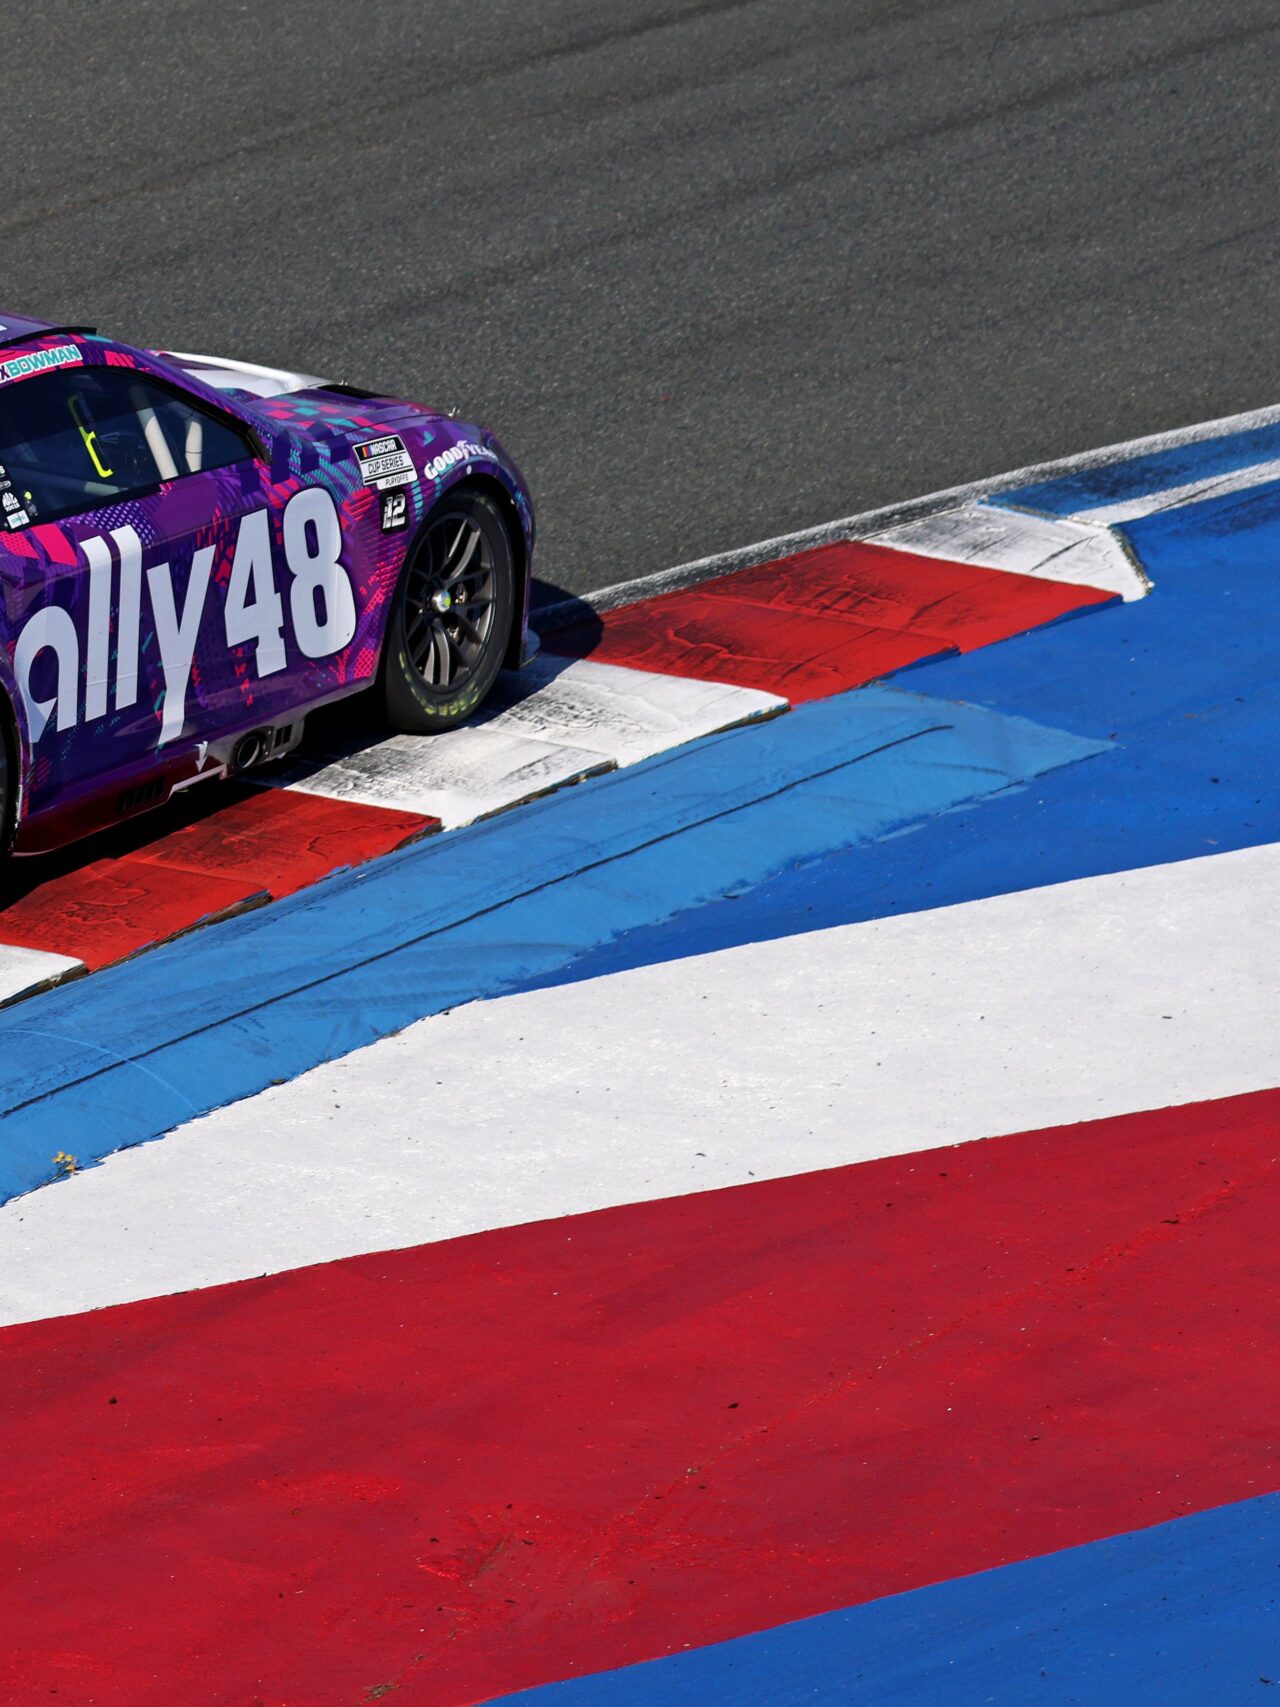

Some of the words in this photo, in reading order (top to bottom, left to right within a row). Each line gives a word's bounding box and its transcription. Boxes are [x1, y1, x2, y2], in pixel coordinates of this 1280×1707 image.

[370, 439, 397, 456] NASCAR
[368, 461, 380, 475] CUP
[381, 456, 404, 471] SERIES
[386, 474, 408, 485] PLAYOFFS
[383, 494, 406, 530] 12
[14, 524, 216, 746] ally
[223, 487, 357, 677] 48
